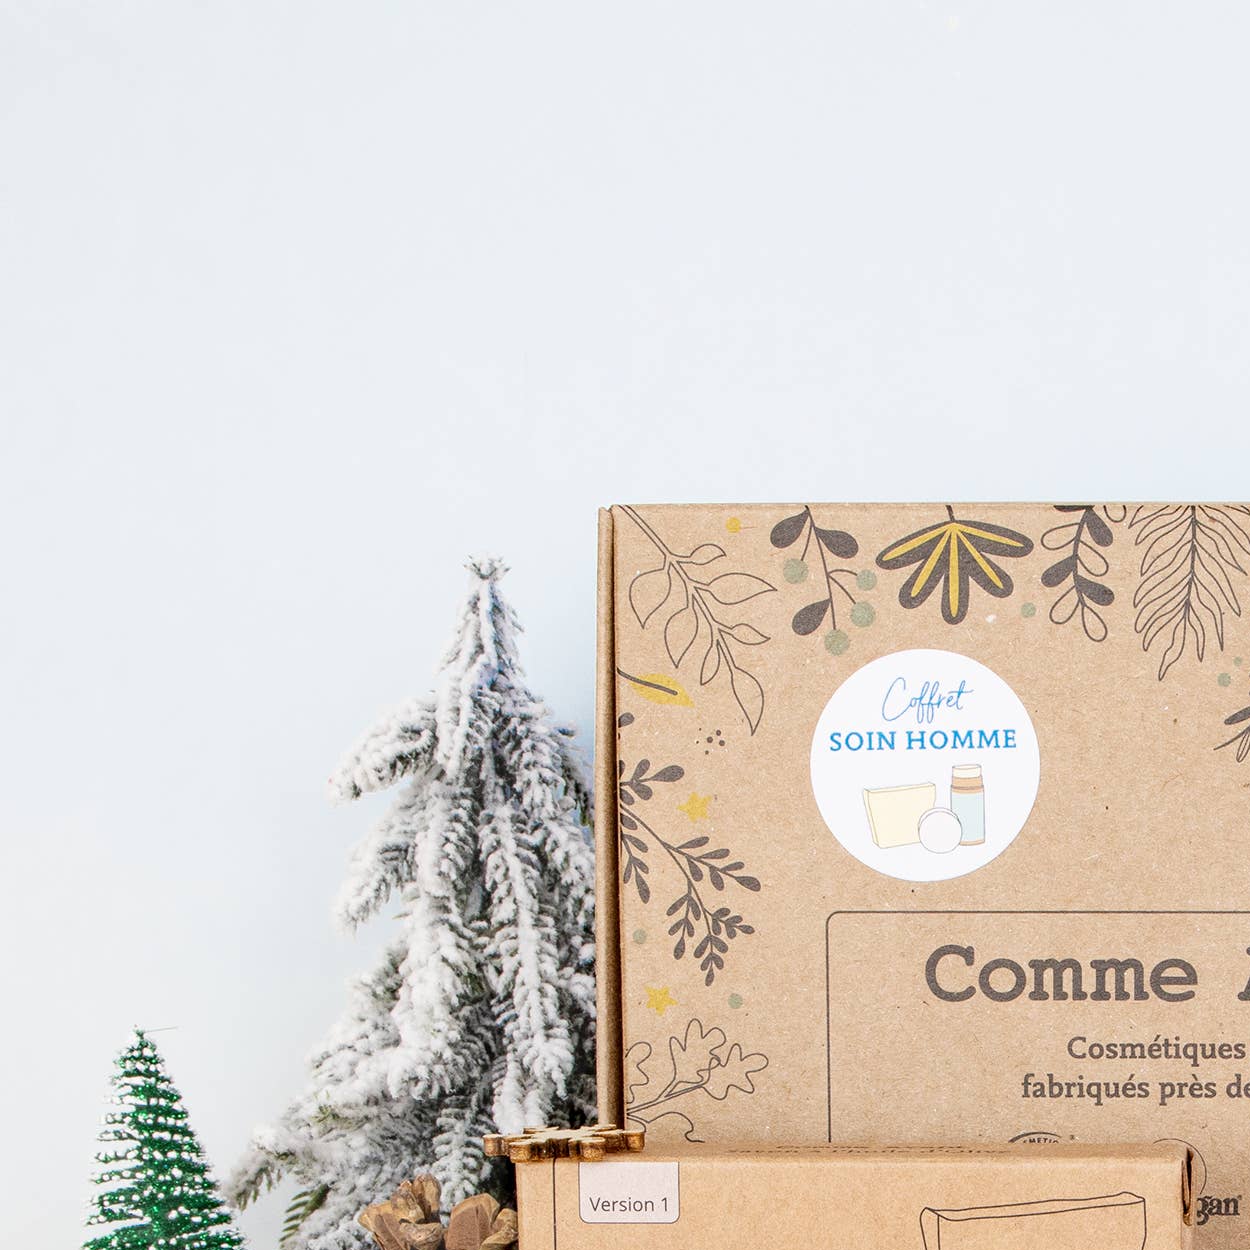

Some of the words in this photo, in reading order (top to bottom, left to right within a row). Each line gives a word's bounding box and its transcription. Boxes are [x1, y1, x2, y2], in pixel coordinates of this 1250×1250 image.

[881, 676, 974, 724] Coffret
[829, 731, 896, 752] SOIN
[905, 729, 1017, 750] HOMME
[923, 944, 1199, 1003] Comme
[1067, 1034, 1246, 1067] Cosmétiques
[1021, 1072, 1150, 1107] fabriqués
[1158, 1073, 1217, 1107] près
[589, 1196, 655, 1213] Version
[661, 1197, 669, 1212] 1
[1196, 1194, 1240, 1226] gan
